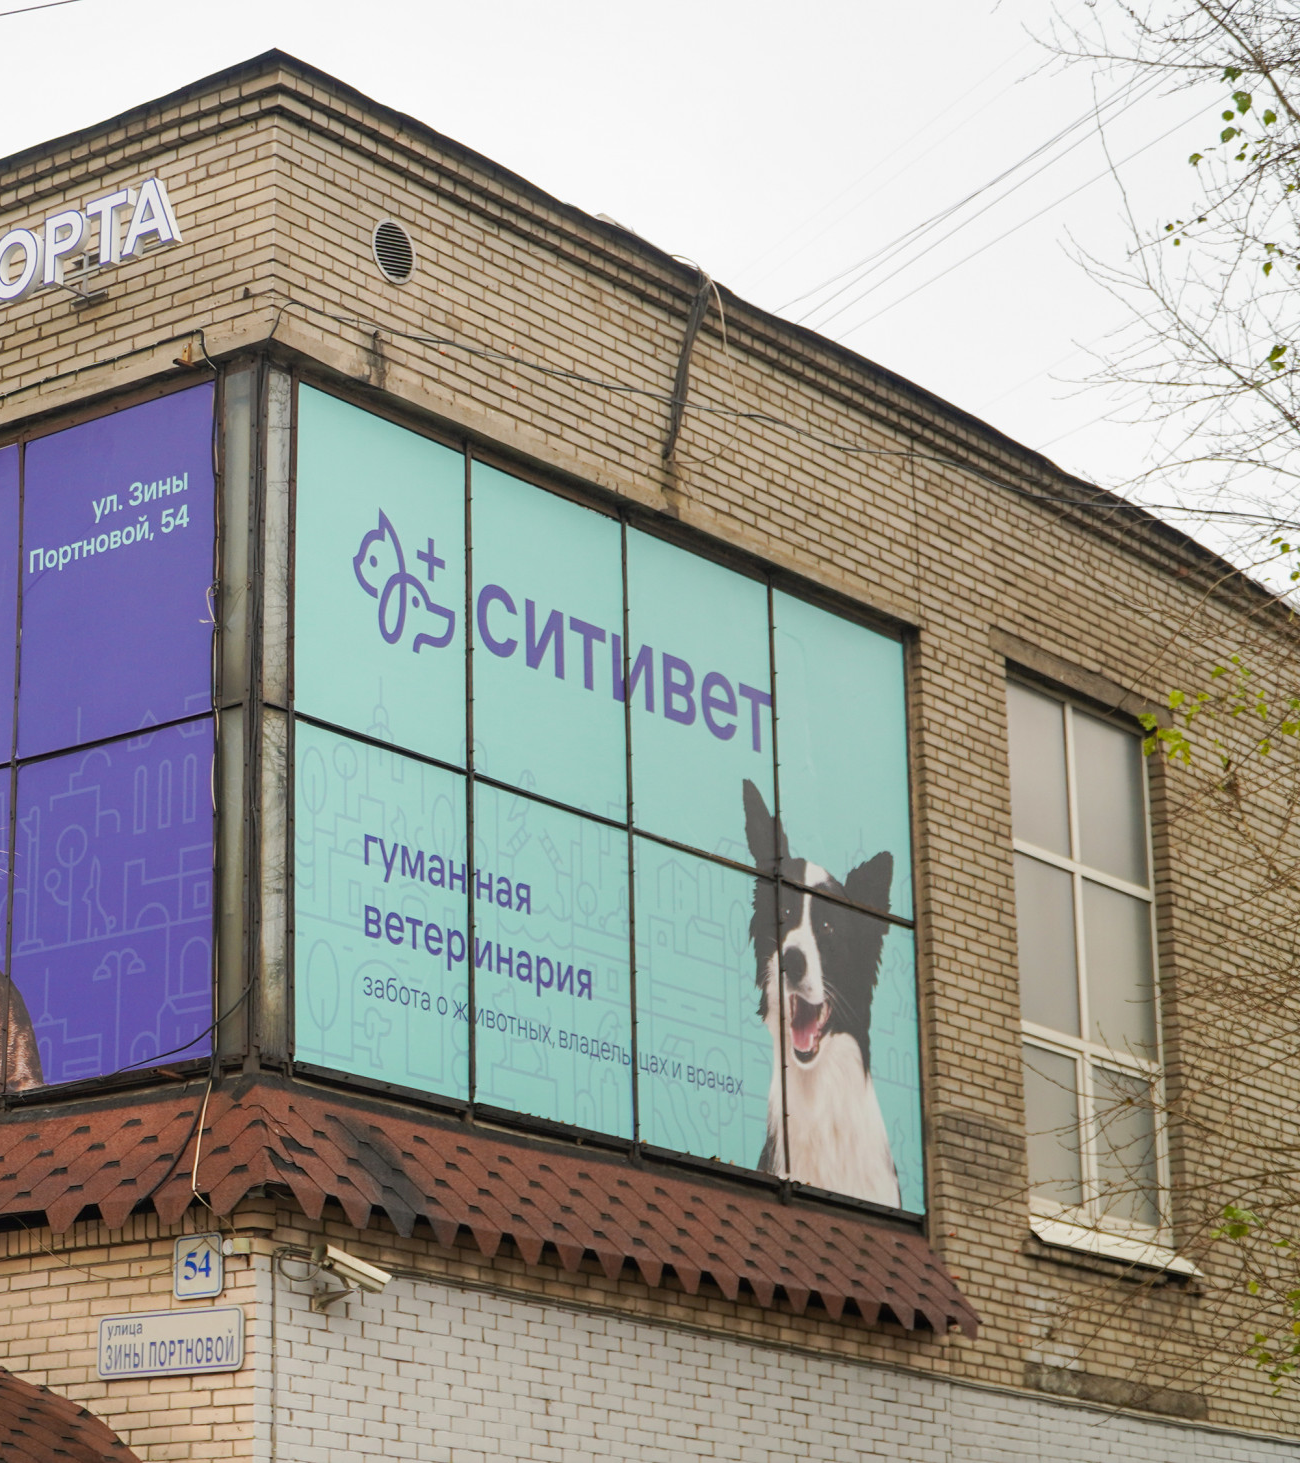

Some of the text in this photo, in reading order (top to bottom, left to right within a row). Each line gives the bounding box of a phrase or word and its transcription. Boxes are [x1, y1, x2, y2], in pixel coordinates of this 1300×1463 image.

[92, 472, 188, 523] ул. Зины
[29, 504, 190, 574] Портновой, 54
[363, 834, 532, 915] гуманная
[363, 904, 593, 1000] ветеринария
[363, 976, 744, 1096] забота о животных, владельцах и врачах
[183, 1249, 212, 1281] 54
[105, 1328, 235, 1371] ЗИНЫ ПОРТНОВОЙ
[107, 1323, 143, 1340] улица
